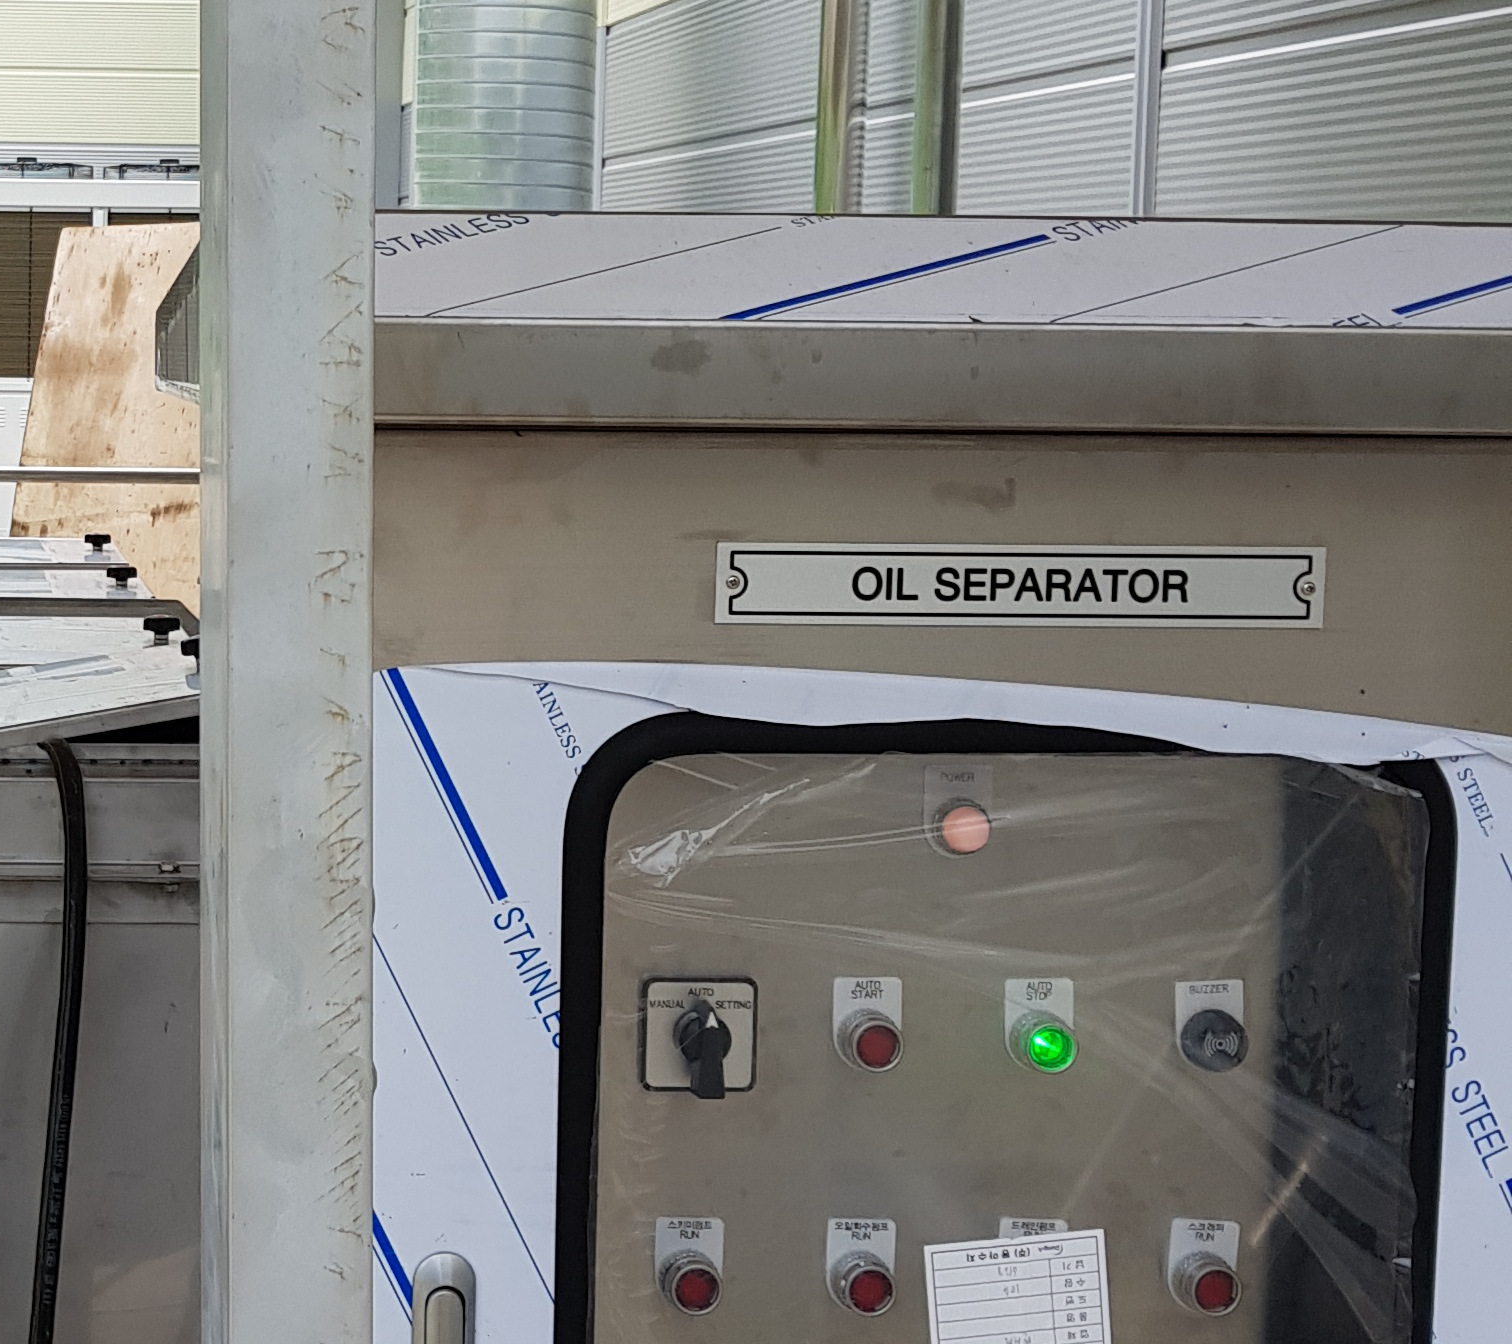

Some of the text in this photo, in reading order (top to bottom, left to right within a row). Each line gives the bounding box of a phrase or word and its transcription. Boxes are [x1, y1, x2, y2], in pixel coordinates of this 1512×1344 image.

[852, 566, 1189, 603] OIL SEPARATOR
[1456, 767, 1494, 838] STEEL
[854, 980, 881, 990] AUTO
[1026, 981, 1053, 991] AUTO
[1189, 983, 1229, 994] BUZZER
[687, 987, 715, 997] AUTO
[850, 989, 884, 999] START
[1026, 990, 1052, 1001] STOP
[649, 999, 686, 1009] MANUAL
[715, 999, 752, 1010] SETTING
[1452, 1080, 1509, 1179] STEEL
[679, 1230, 700, 1240] RUN
[851, 1232, 871, 1241] RUN
[1195, 1232, 1215, 1242] RUN
[1062, 1260, 1085, 1271] 납기
